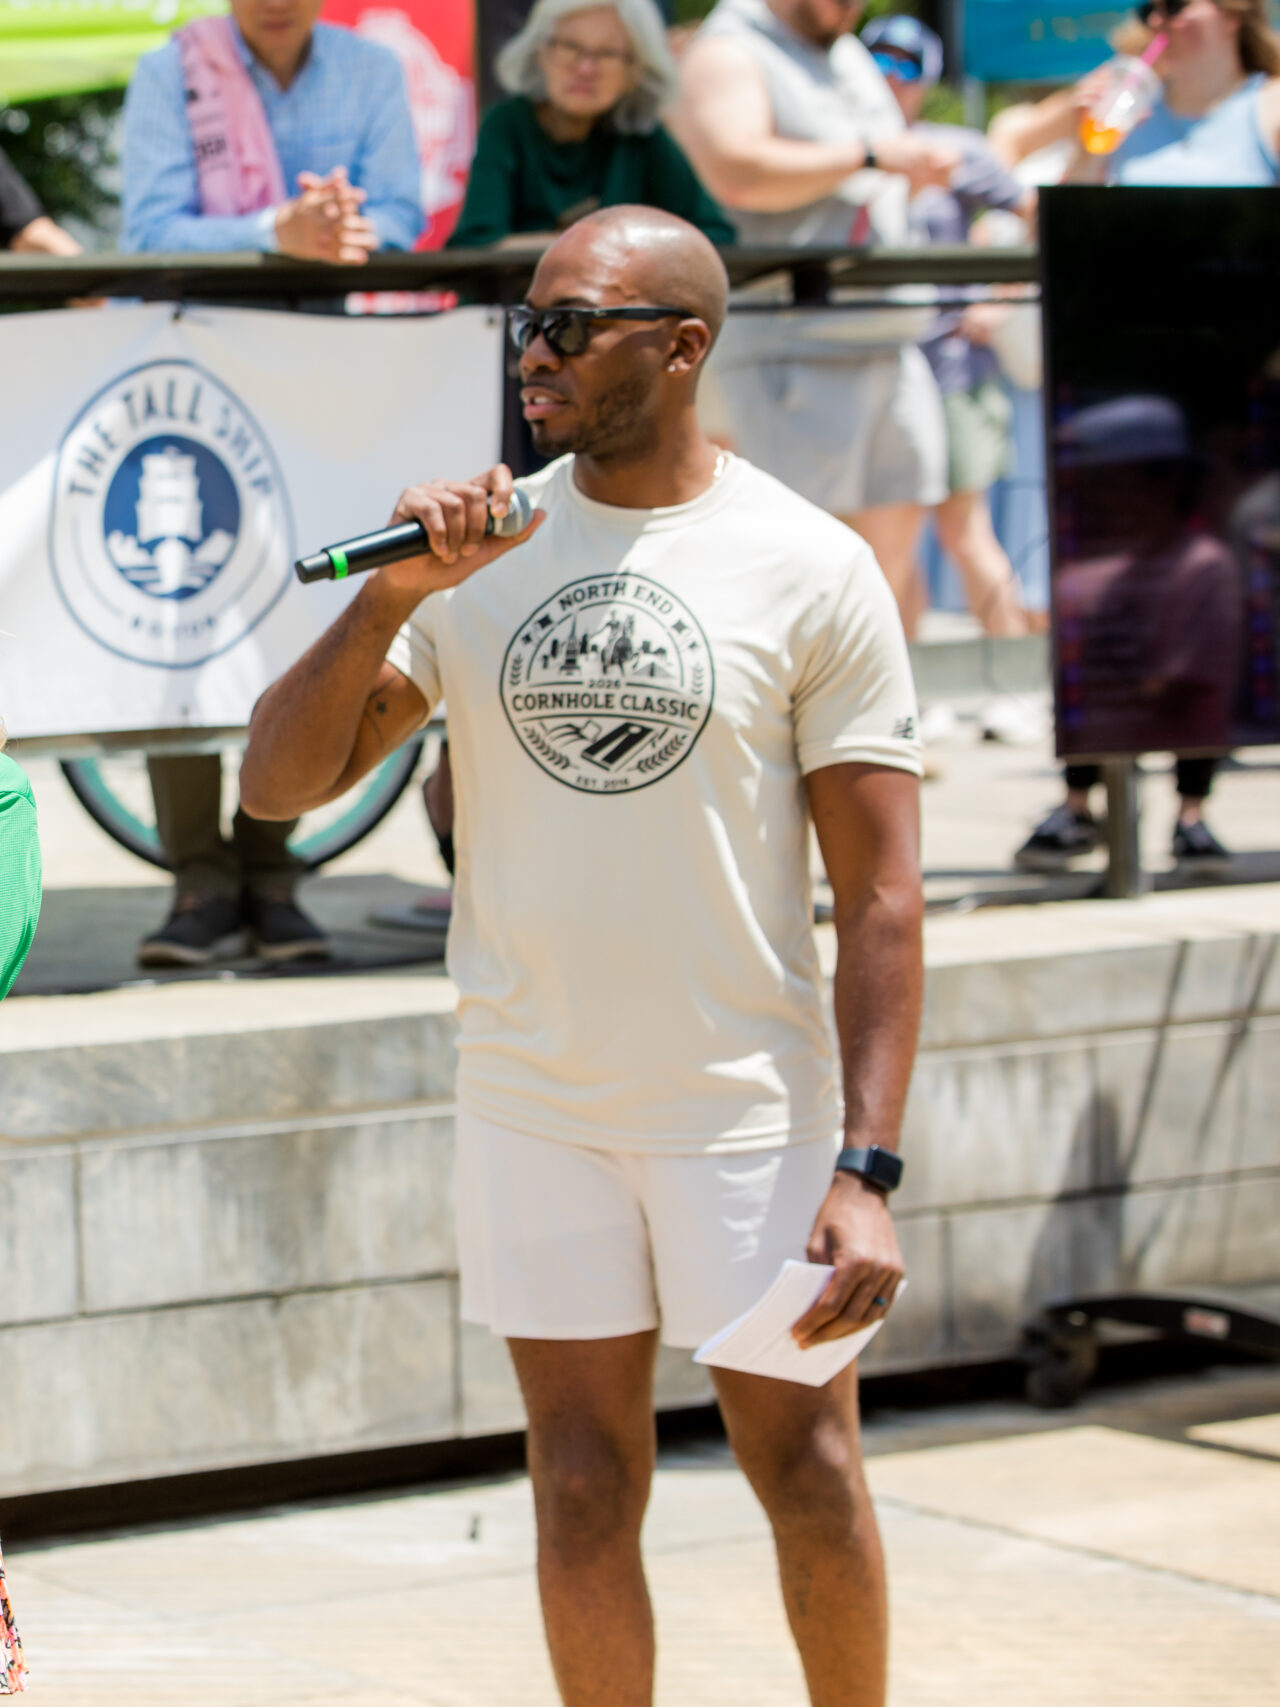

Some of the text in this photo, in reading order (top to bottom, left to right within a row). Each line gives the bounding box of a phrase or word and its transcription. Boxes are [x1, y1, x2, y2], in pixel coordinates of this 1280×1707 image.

[67, 422, 121, 496] THE
[122, 378, 204, 430] TALL
[558, 580, 675, 616] NORTH END
[511, 692, 701, 722] CORNHOLE CLASSIC
